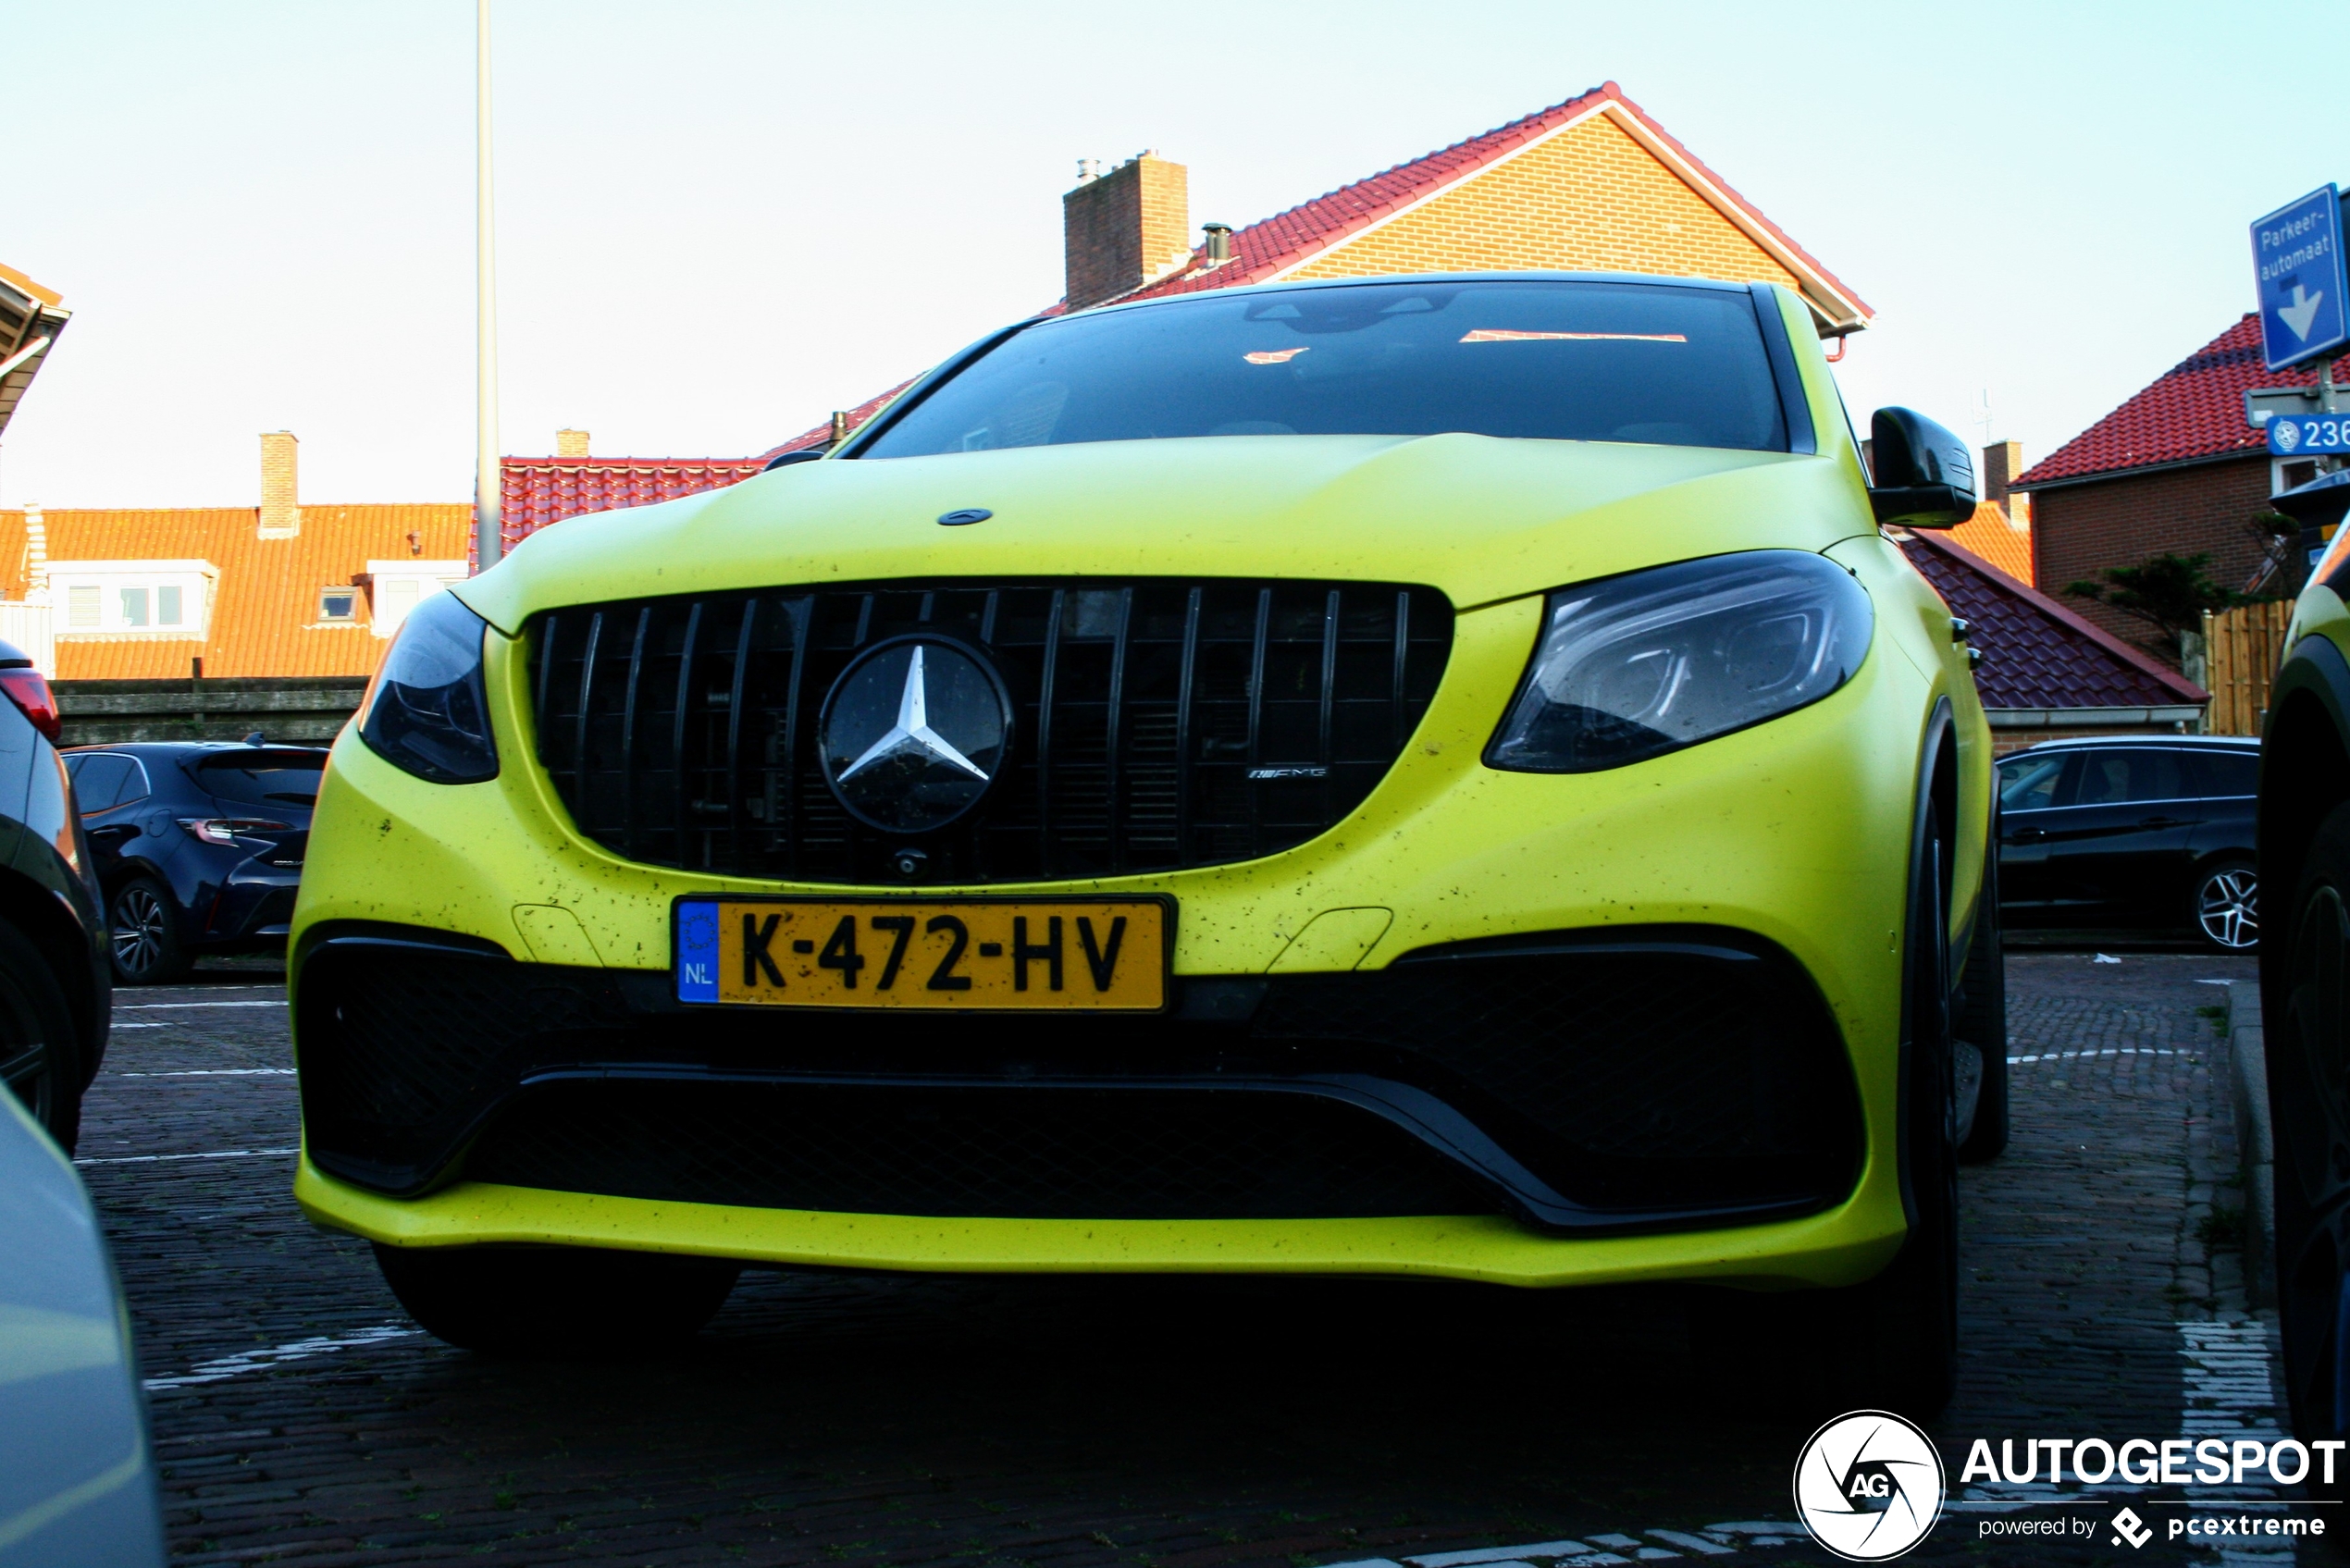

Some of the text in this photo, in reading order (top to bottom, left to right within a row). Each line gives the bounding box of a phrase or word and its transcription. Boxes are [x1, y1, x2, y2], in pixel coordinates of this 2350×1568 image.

[2261, 212, 2325, 252] Parkeer-
[2261, 233, 2331, 281] automaat
[685, 963, 713, 985] NL
[743, 912, 1128, 993] K-472-HV
